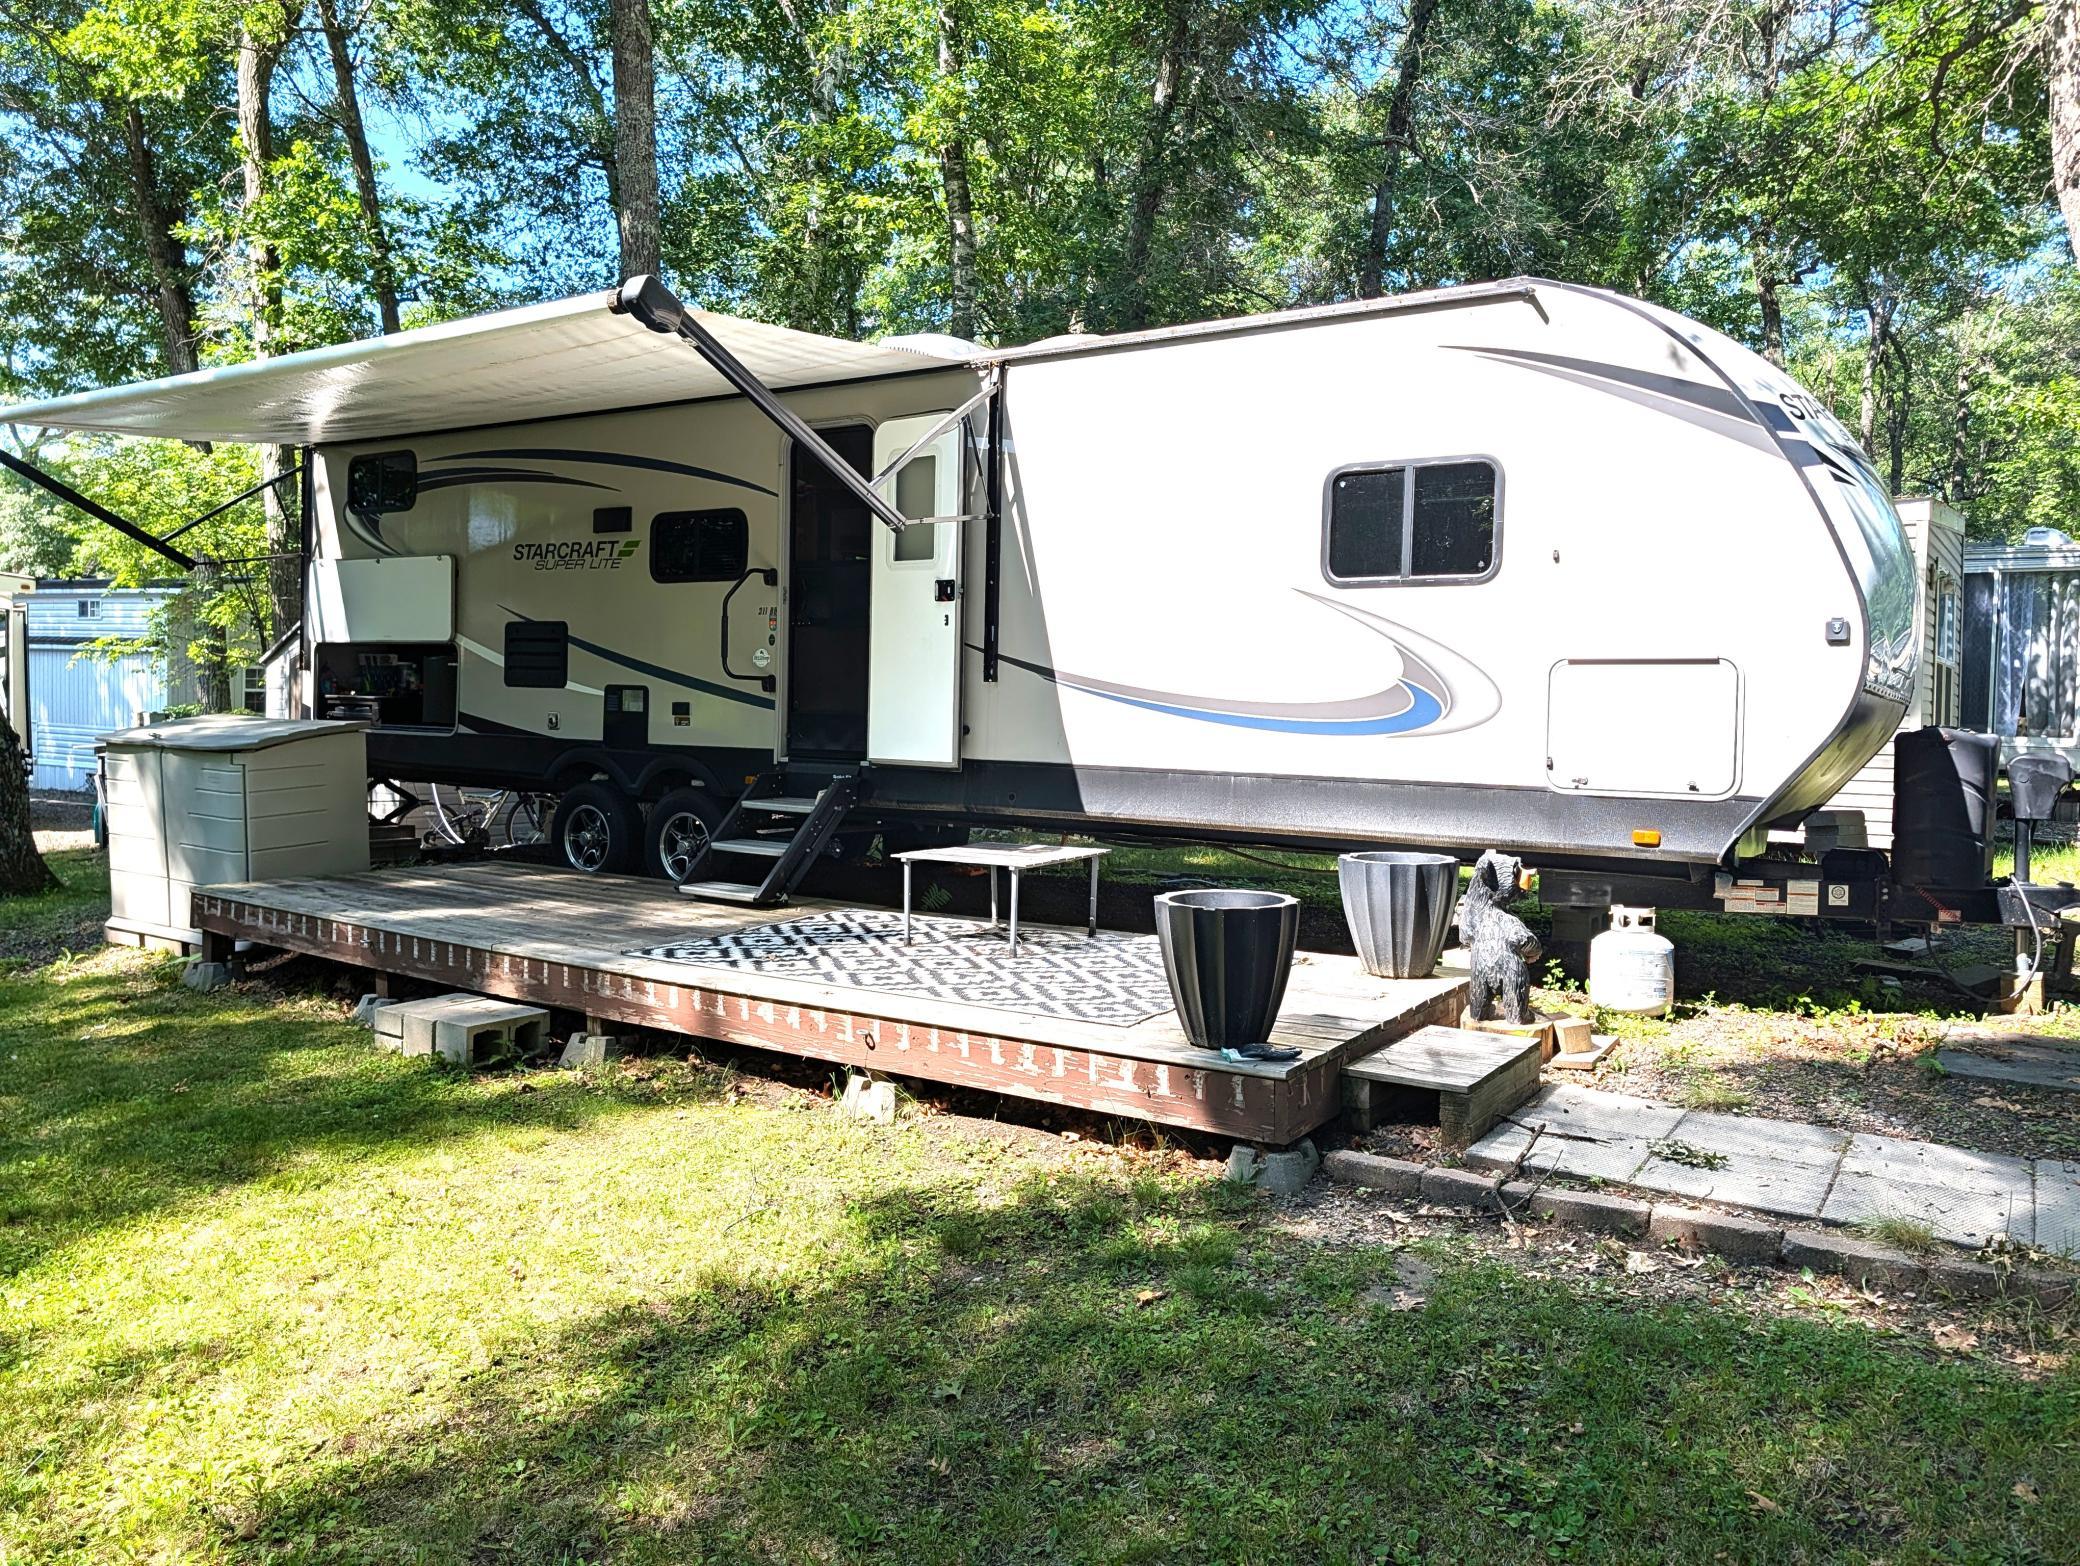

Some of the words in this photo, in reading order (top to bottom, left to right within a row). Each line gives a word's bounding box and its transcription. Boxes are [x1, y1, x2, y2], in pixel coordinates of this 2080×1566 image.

[513, 540, 620, 561] STARCRAFT
[534, 558, 585, 571] SUPER
[589, 557, 622, 569] LITE
